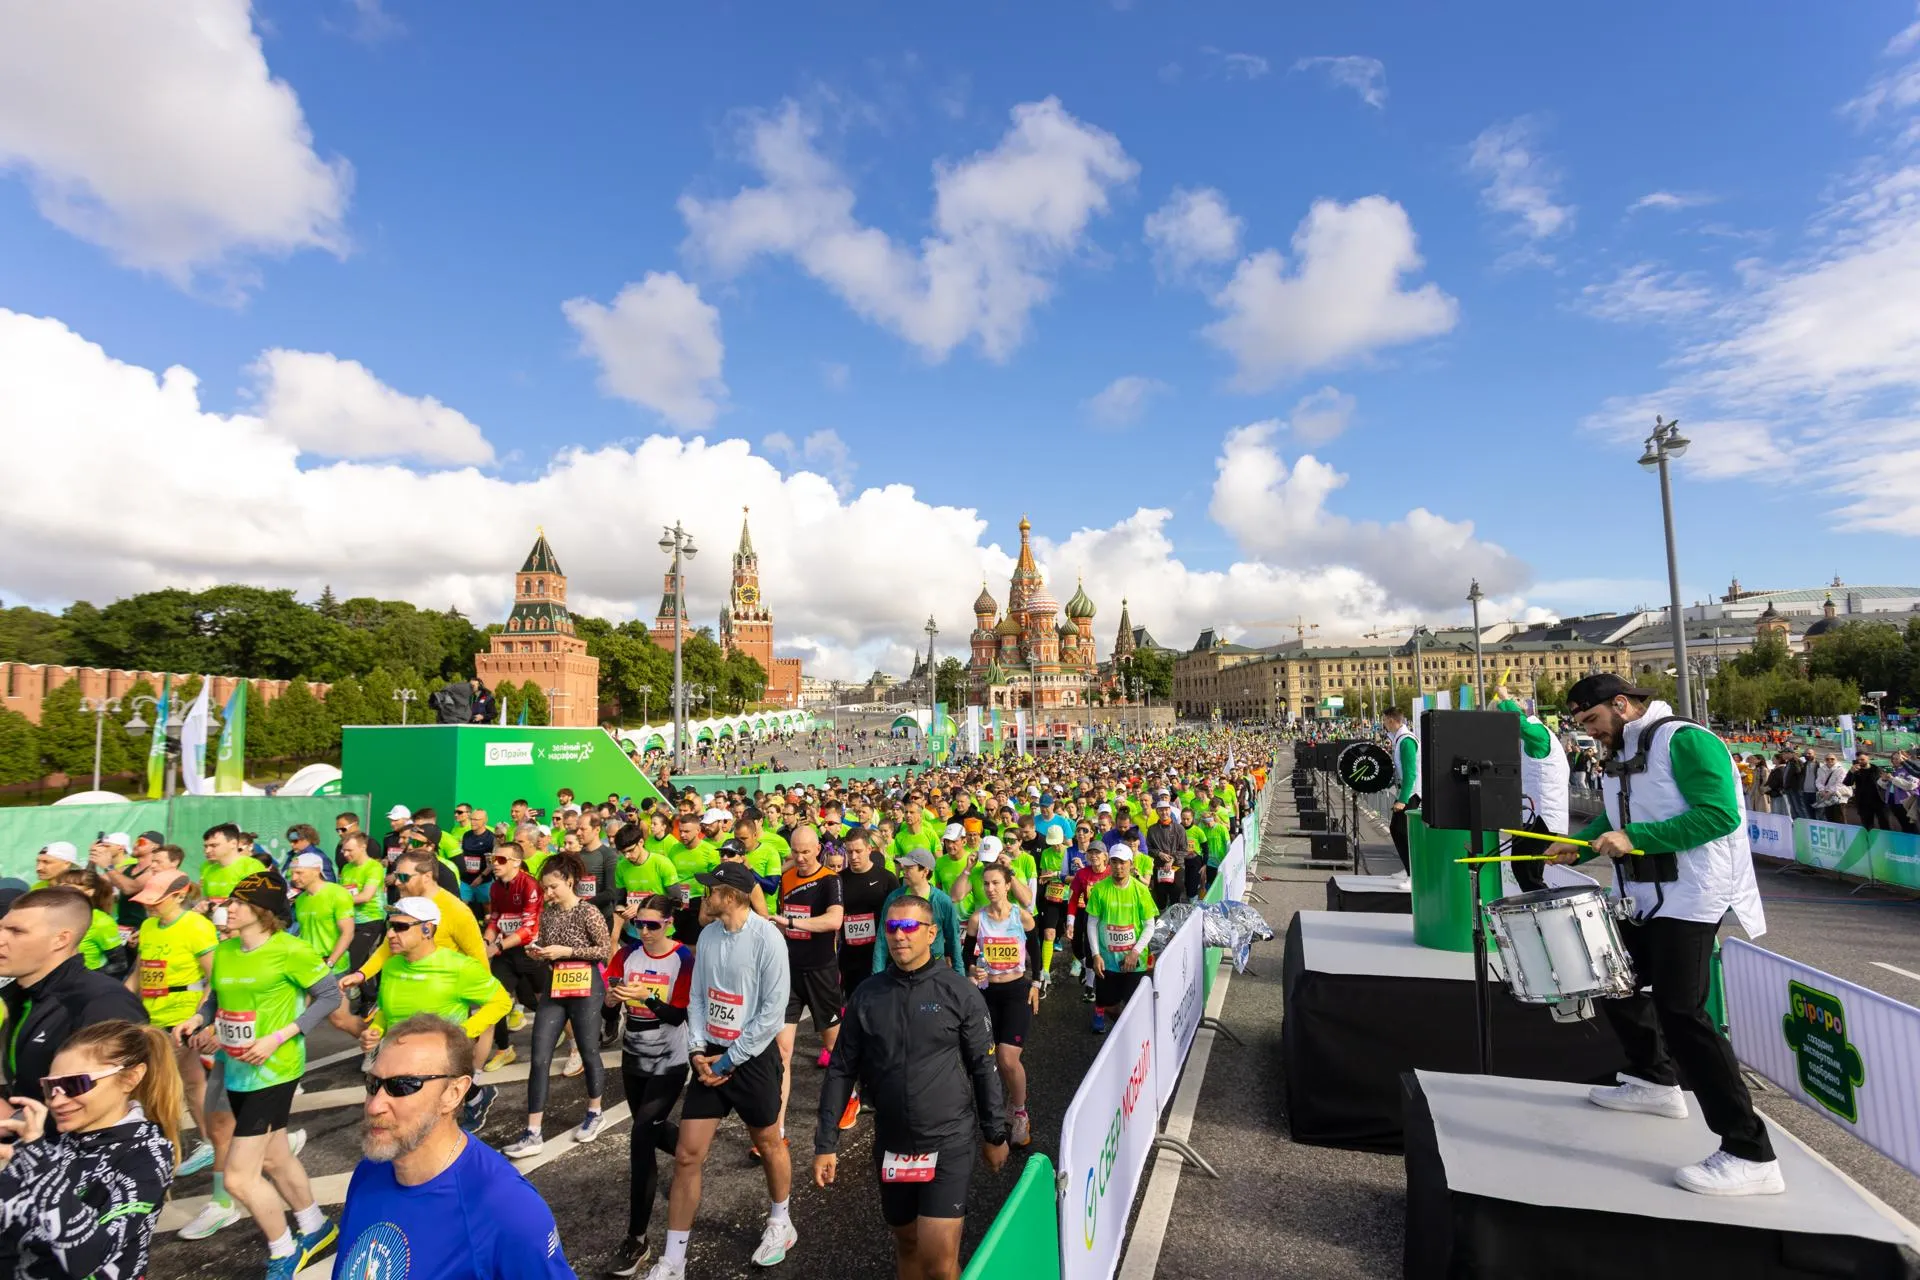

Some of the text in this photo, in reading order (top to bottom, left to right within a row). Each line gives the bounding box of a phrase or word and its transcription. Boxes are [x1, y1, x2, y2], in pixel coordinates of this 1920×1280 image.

[500, 748, 528, 759] Прайм
[548, 751, 579, 761] марафон
[1809, 824, 1846, 850] БЕГИ
[848, 923, 870, 934] 8949
[1108, 932, 1134, 942] 10083
[986, 947, 1018, 957] 11202
[555, 972, 590, 983] 10584
[709, 1002, 735, 1021] 8754
[1792, 993, 1843, 1035] Gipopo
[1807, 1033, 1834, 1054] создано
[1099, 1107, 1121, 1198] СБЕР
[888, 1167, 895, 1178] C
